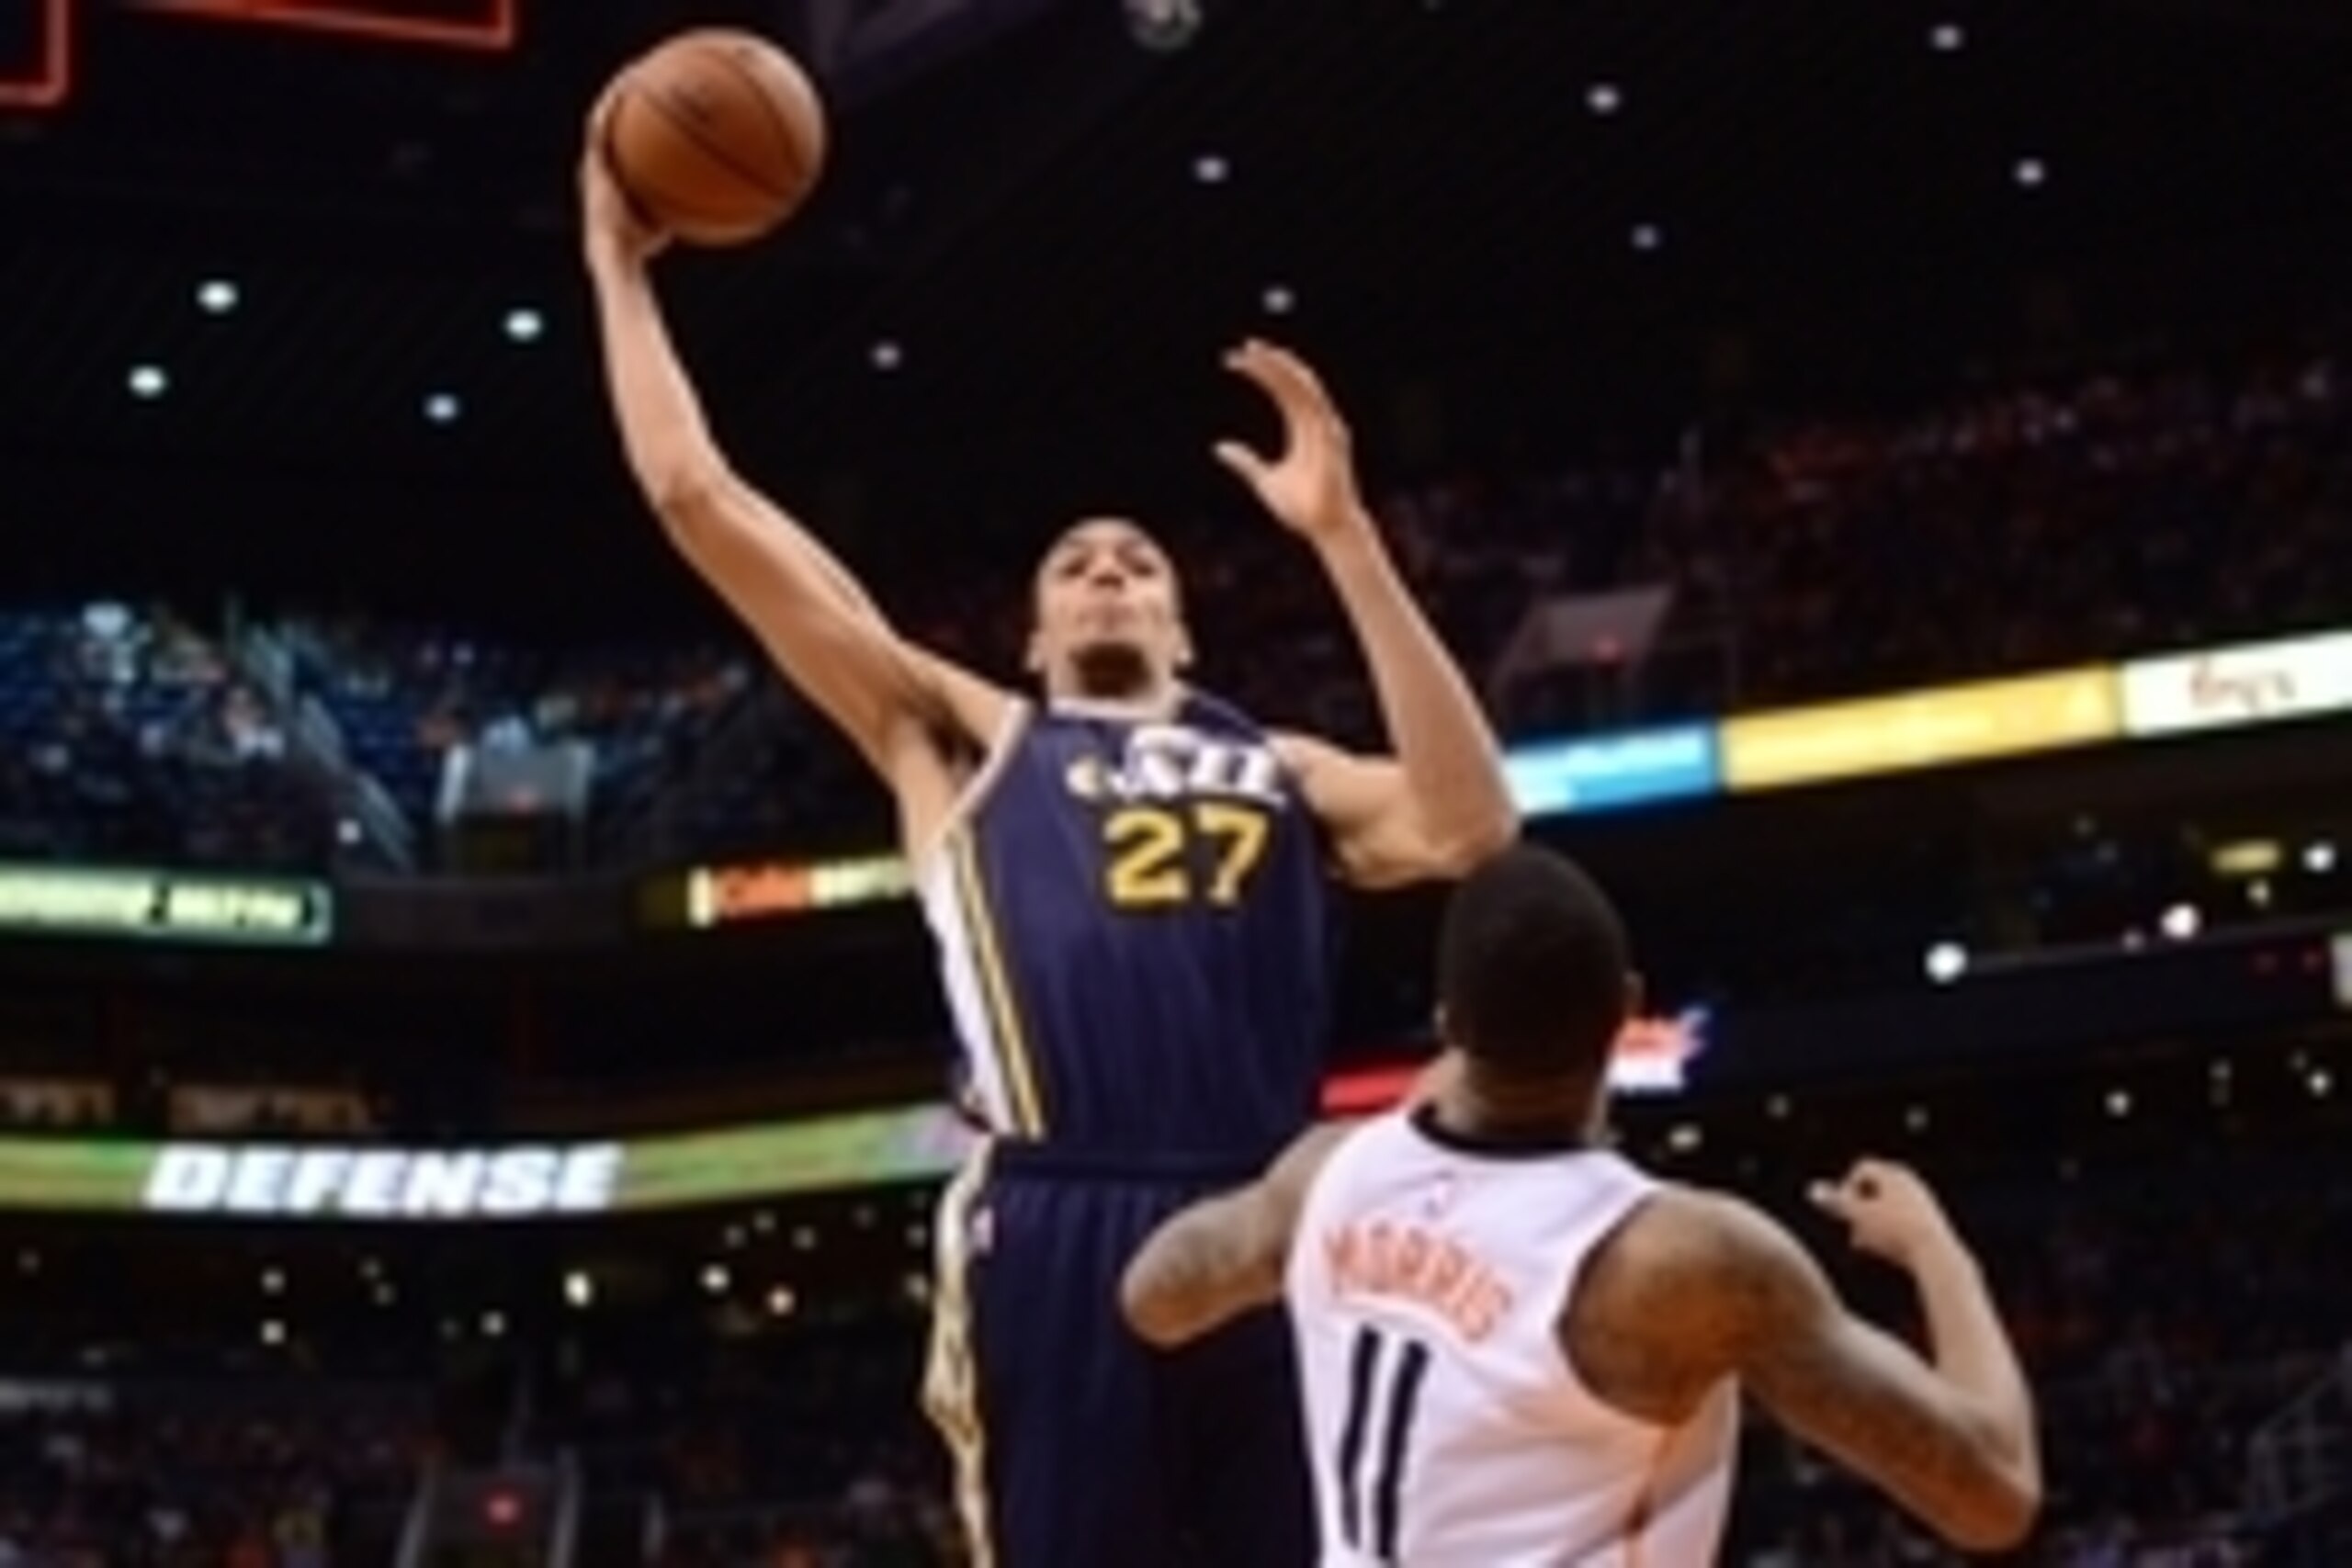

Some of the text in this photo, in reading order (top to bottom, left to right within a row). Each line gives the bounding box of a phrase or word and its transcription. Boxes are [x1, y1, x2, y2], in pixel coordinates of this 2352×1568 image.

[1104, 806, 1268, 906] 27
[145, 1143, 621, 1216] DEFENSE
[1323, 1220, 1514, 1341] MORRIS
[1339, 1323, 1430, 1560] 11
